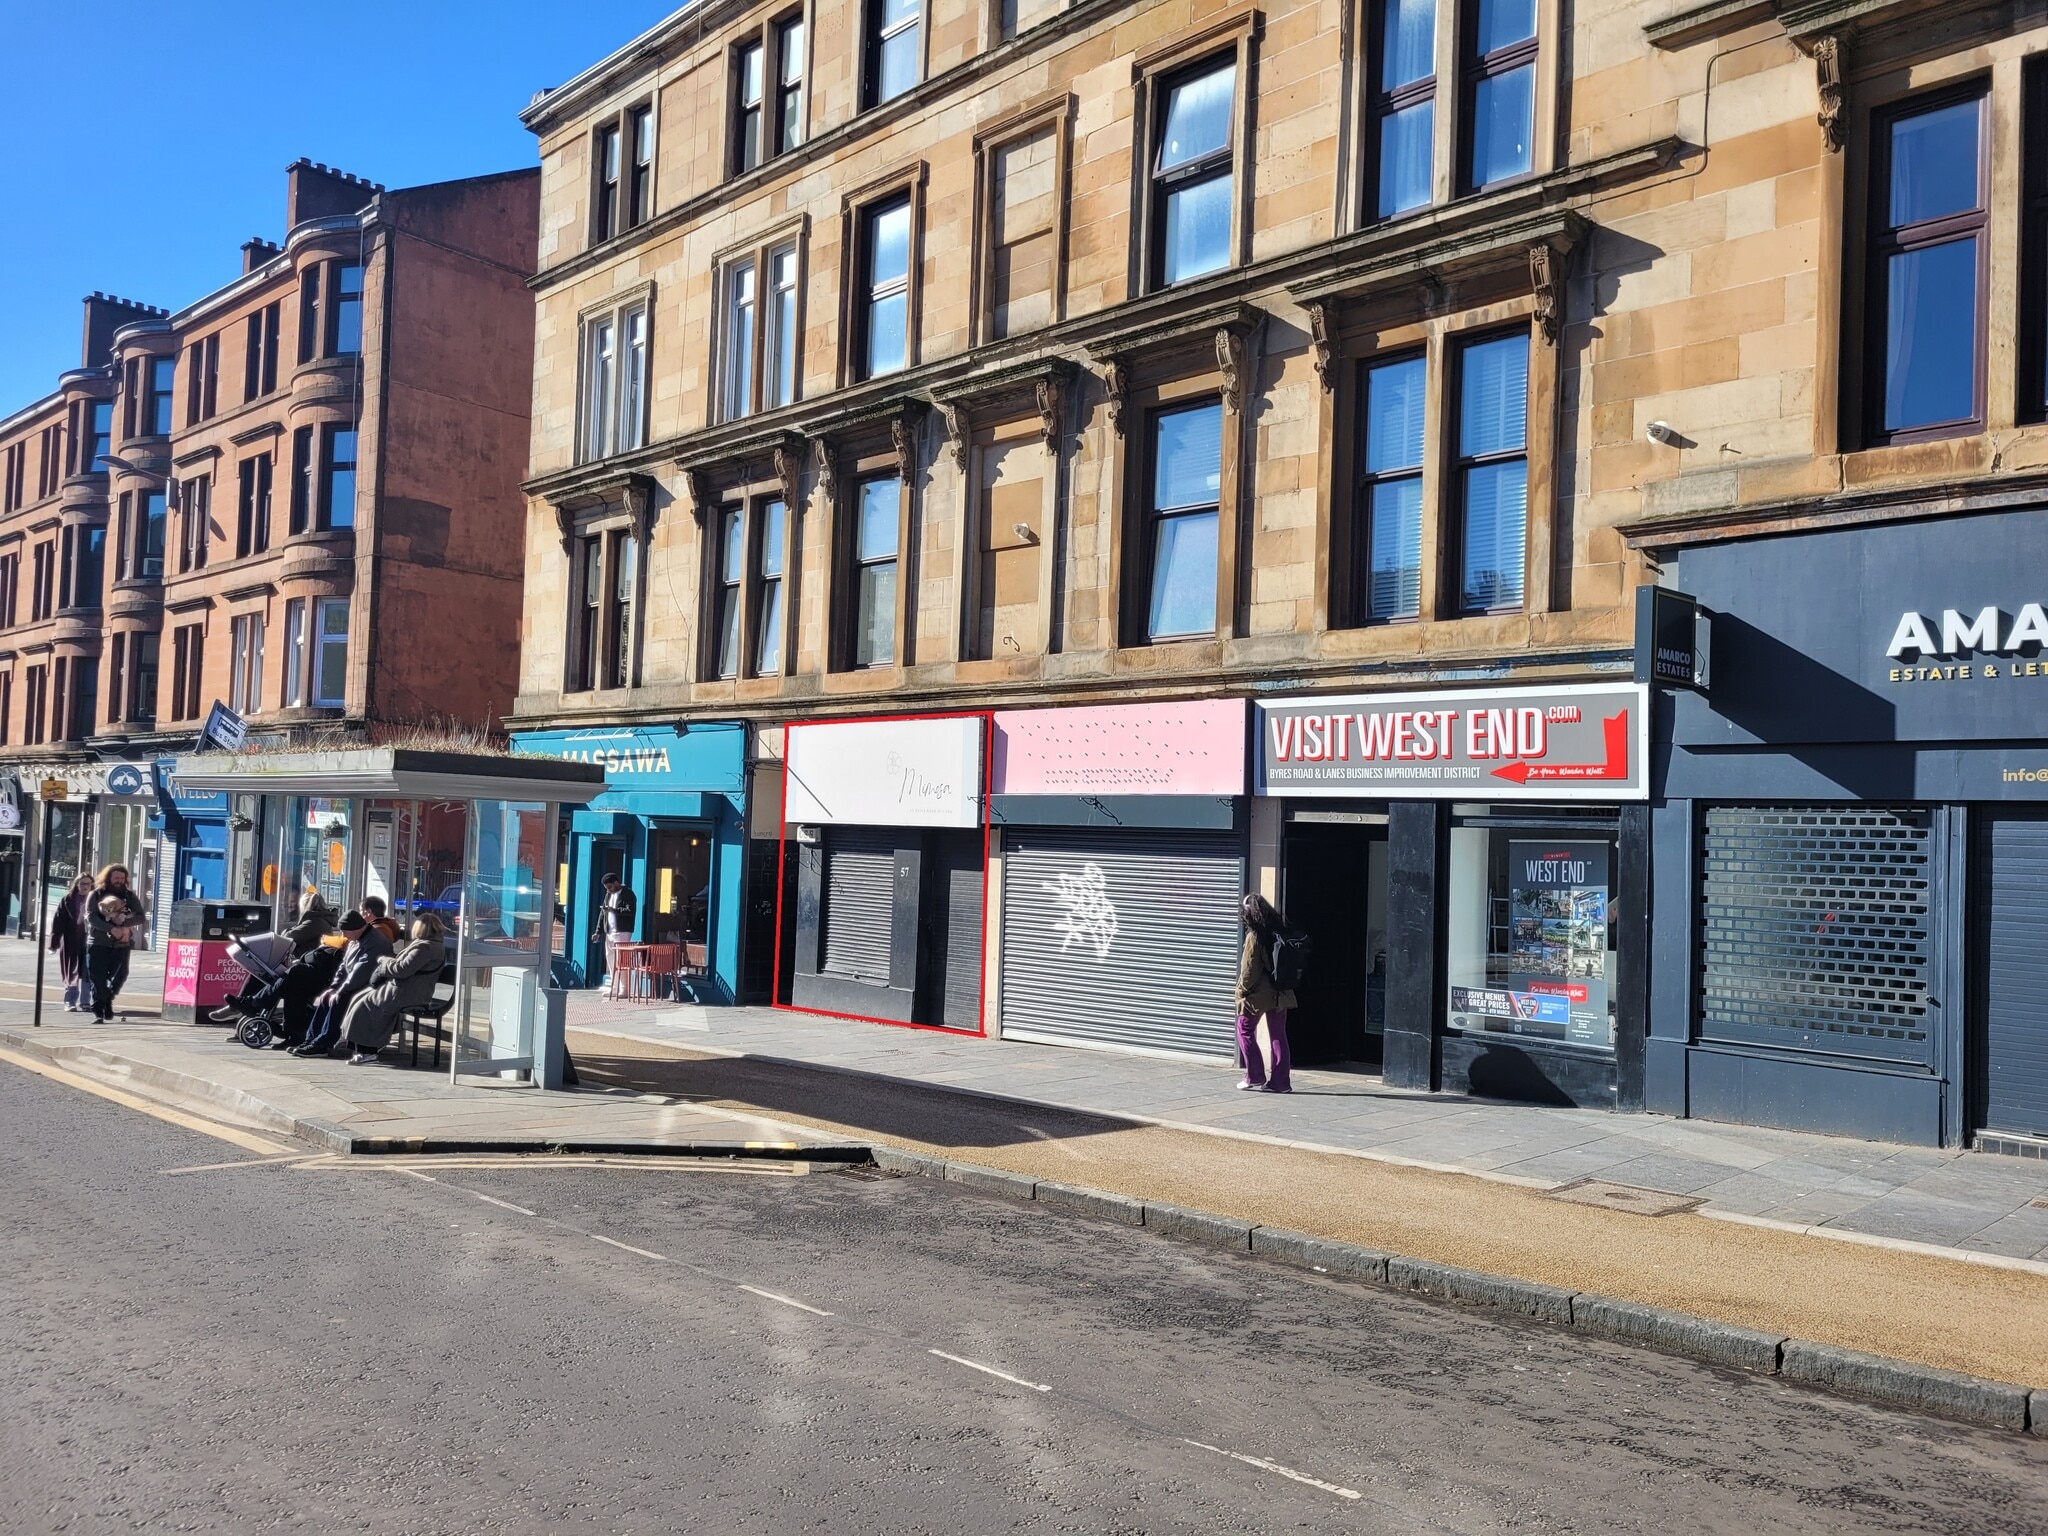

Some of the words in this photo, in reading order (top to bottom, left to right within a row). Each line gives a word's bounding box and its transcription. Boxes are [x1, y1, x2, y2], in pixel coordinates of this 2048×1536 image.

[1886, 603, 2048, 656] AMA
[1657, 647, 1691, 665] AMARCO
[1657, 661, 1691, 678] ESTATES
[1889, 665, 1970, 681] ESTATE
[1983, 664, 1997, 677] &
[212, 727, 222, 739] Bus
[222, 735, 236, 749] Stop
[1270, 714, 1354, 761] VISIT
[1356, 710, 1458, 760] WEST
[1466, 707, 1546, 759] END
[1269, 768, 1292, 779] BYRES
[1293, 768, 1314, 779] ROAD
[1314, 768, 1321, 779] &
[1322, 768, 1346, 779] LANES
[1346, 767, 1383, 779] BUSINESS
[1384, 767, 1442, 779] IMPROVEMENT
[1444, 766, 1480, 779] DISTRICT
[900, 868, 909, 877] 57
[1525, 860, 1559, 883] WEST
[1561, 861, 1585, 883] END
[178, 944, 198, 956] PEOPLE
[181, 957, 197, 968] MAKE
[169, 966, 195, 979] GLASGOW
[203, 973, 247, 981] GLASGOW
[1453, 989, 1485, 1000] EXCLUSIVE
[1485, 992, 1506, 1001] MENUS
[1468, 999, 1487, 1008] GREAT
[1488, 1001, 1511, 1010] PRICES
